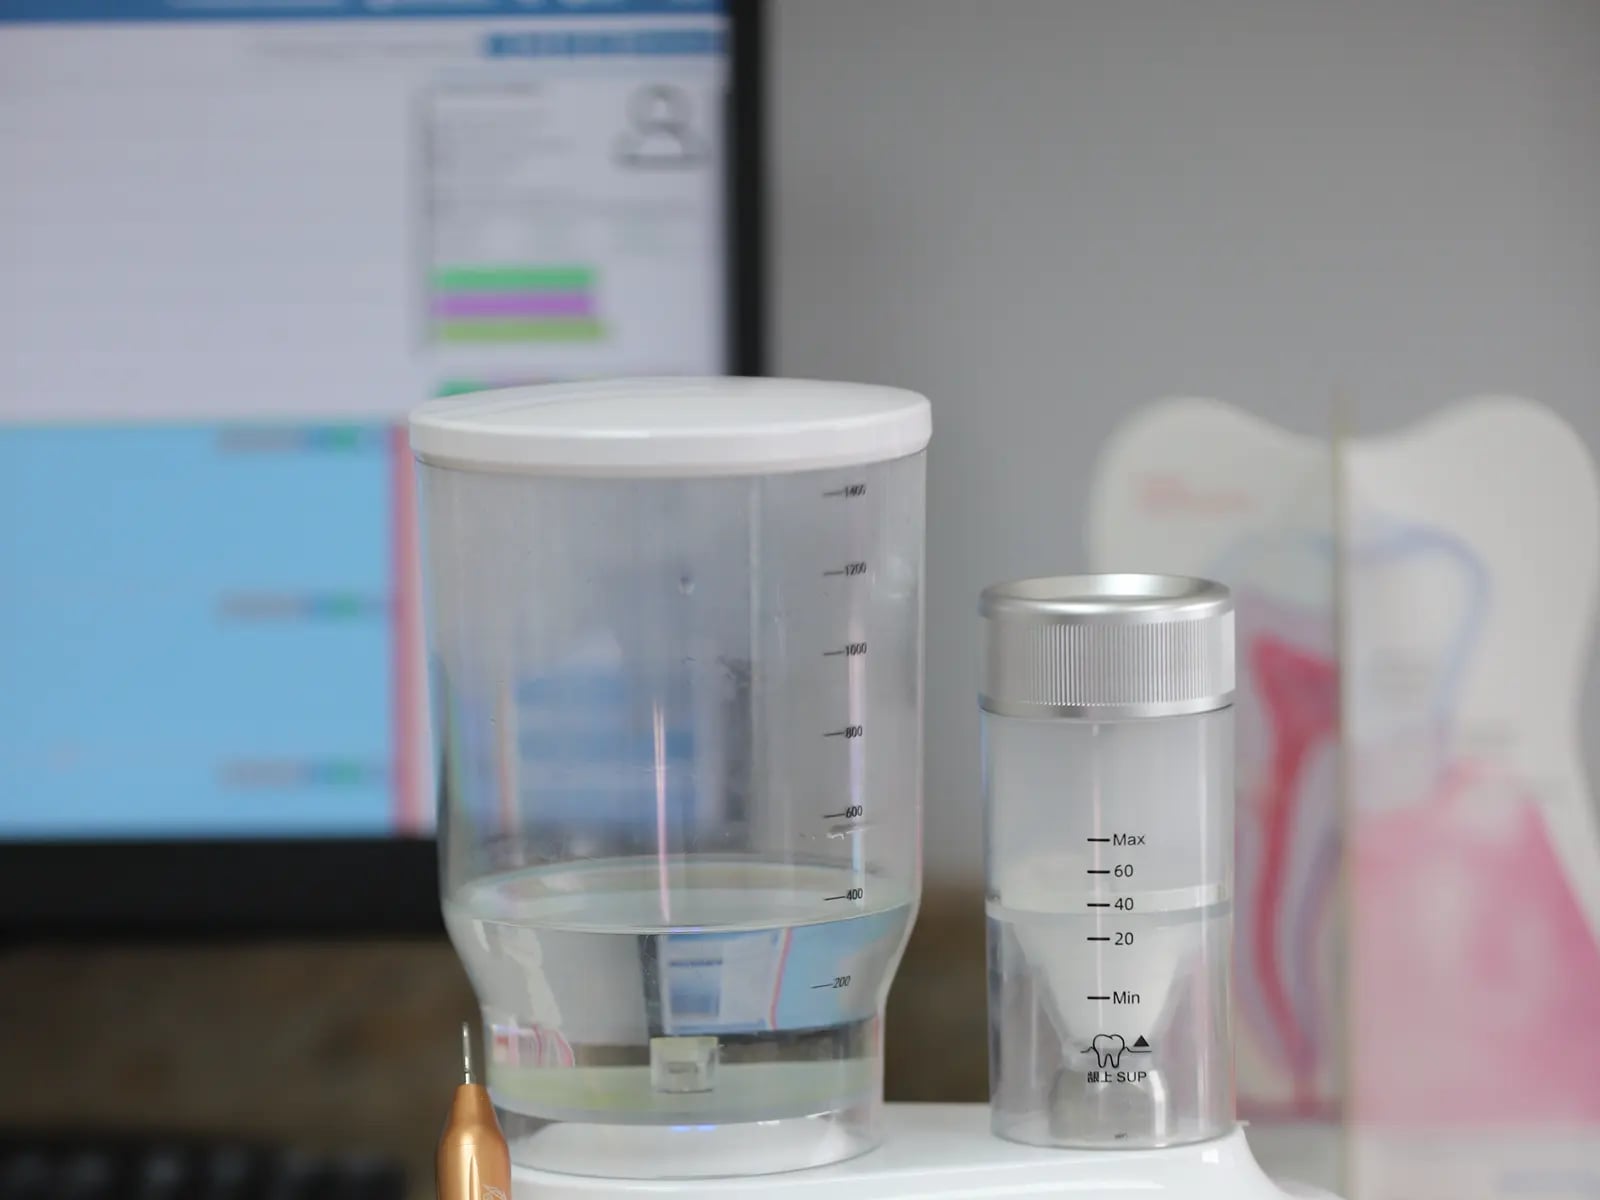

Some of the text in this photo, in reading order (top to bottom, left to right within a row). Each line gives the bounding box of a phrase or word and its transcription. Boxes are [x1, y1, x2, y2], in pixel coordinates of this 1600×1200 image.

[844, 562, 867, 577] 1200
[845, 642, 867, 657] 1000
[844, 726, 863, 739] 800
[845, 805, 863, 818] 600
[1112, 833, 1146, 846] Max
[1113, 864, 1134, 878] 60
[846, 887, 864, 901] 400
[1113, 897, 1134, 911] 40
[1114, 932, 1134, 946] 20
[832, 975, 851, 989] 200
[1112, 991, 1140, 1005] Min
[1116, 1071, 1147, 1083] SUP
